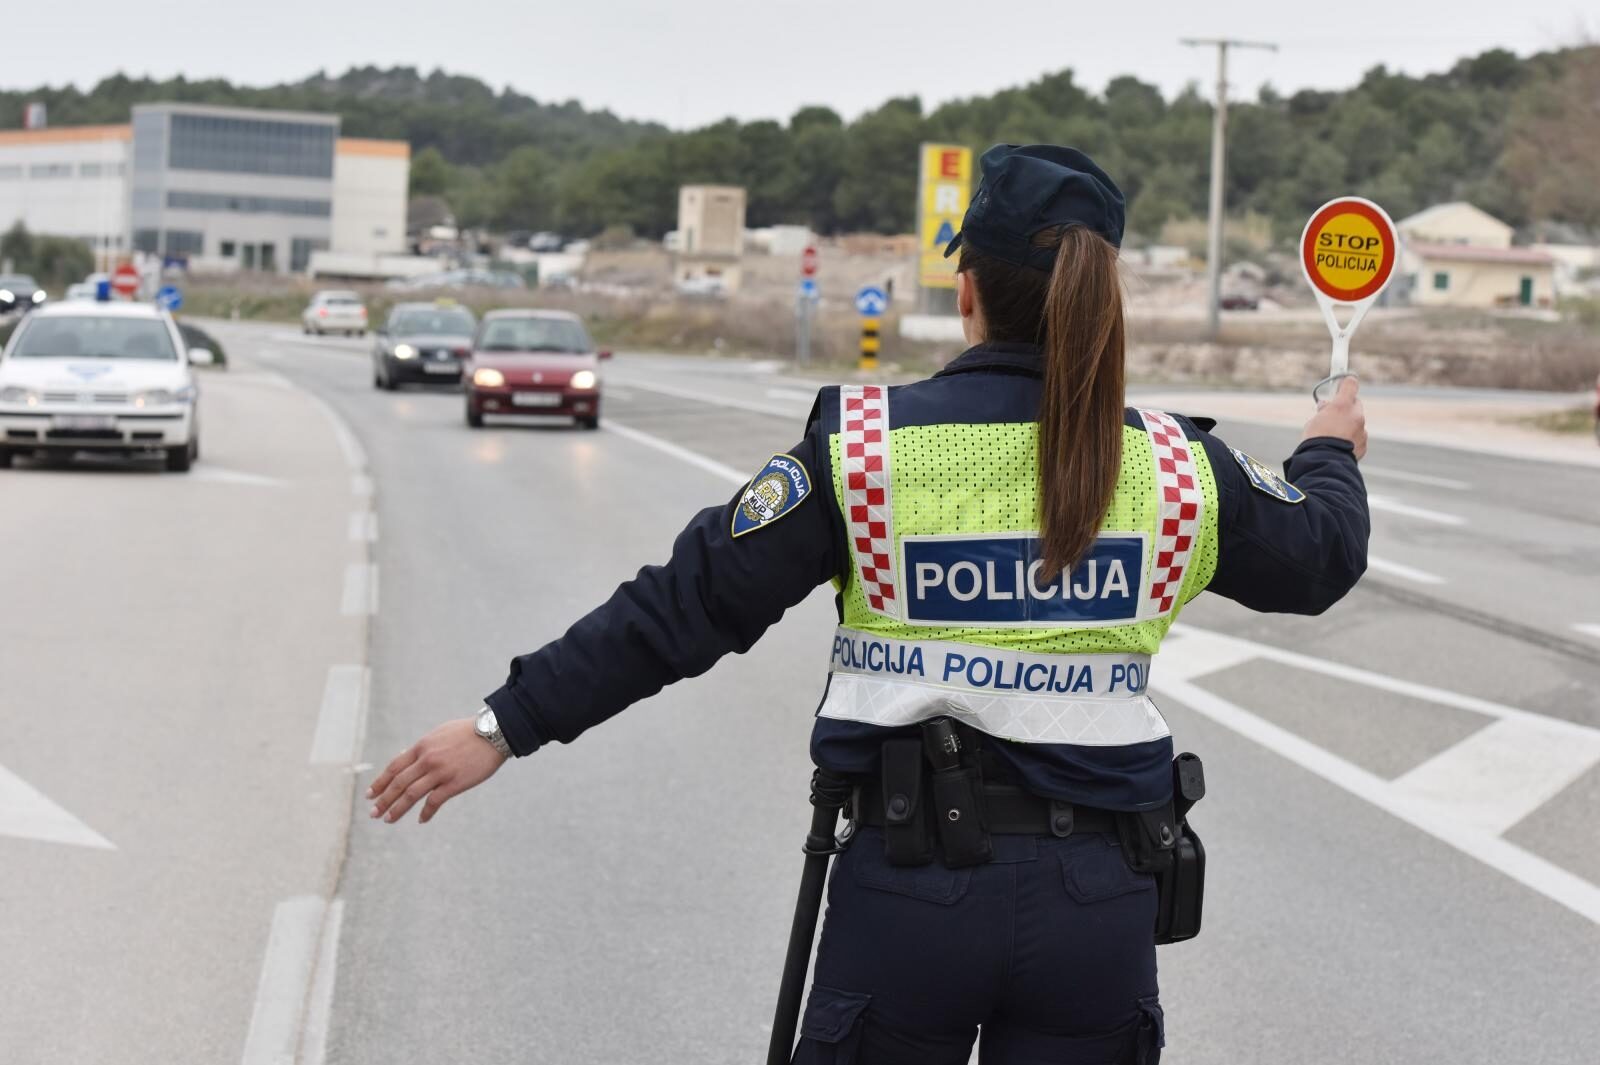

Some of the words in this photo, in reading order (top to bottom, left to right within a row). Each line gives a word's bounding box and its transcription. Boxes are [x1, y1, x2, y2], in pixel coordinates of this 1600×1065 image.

[934, 151, 961, 246] ERA
[1319, 232, 1380, 250] STOP
[1316, 253, 1377, 272] POLICIJA
[769, 459, 806, 498] POLICIJA
[749, 495, 767, 514] MUP
[915, 558, 1130, 601] POLICIJA
[832, 635, 925, 677] POLICIJA
[943, 651, 1094, 694] POLICIJA
